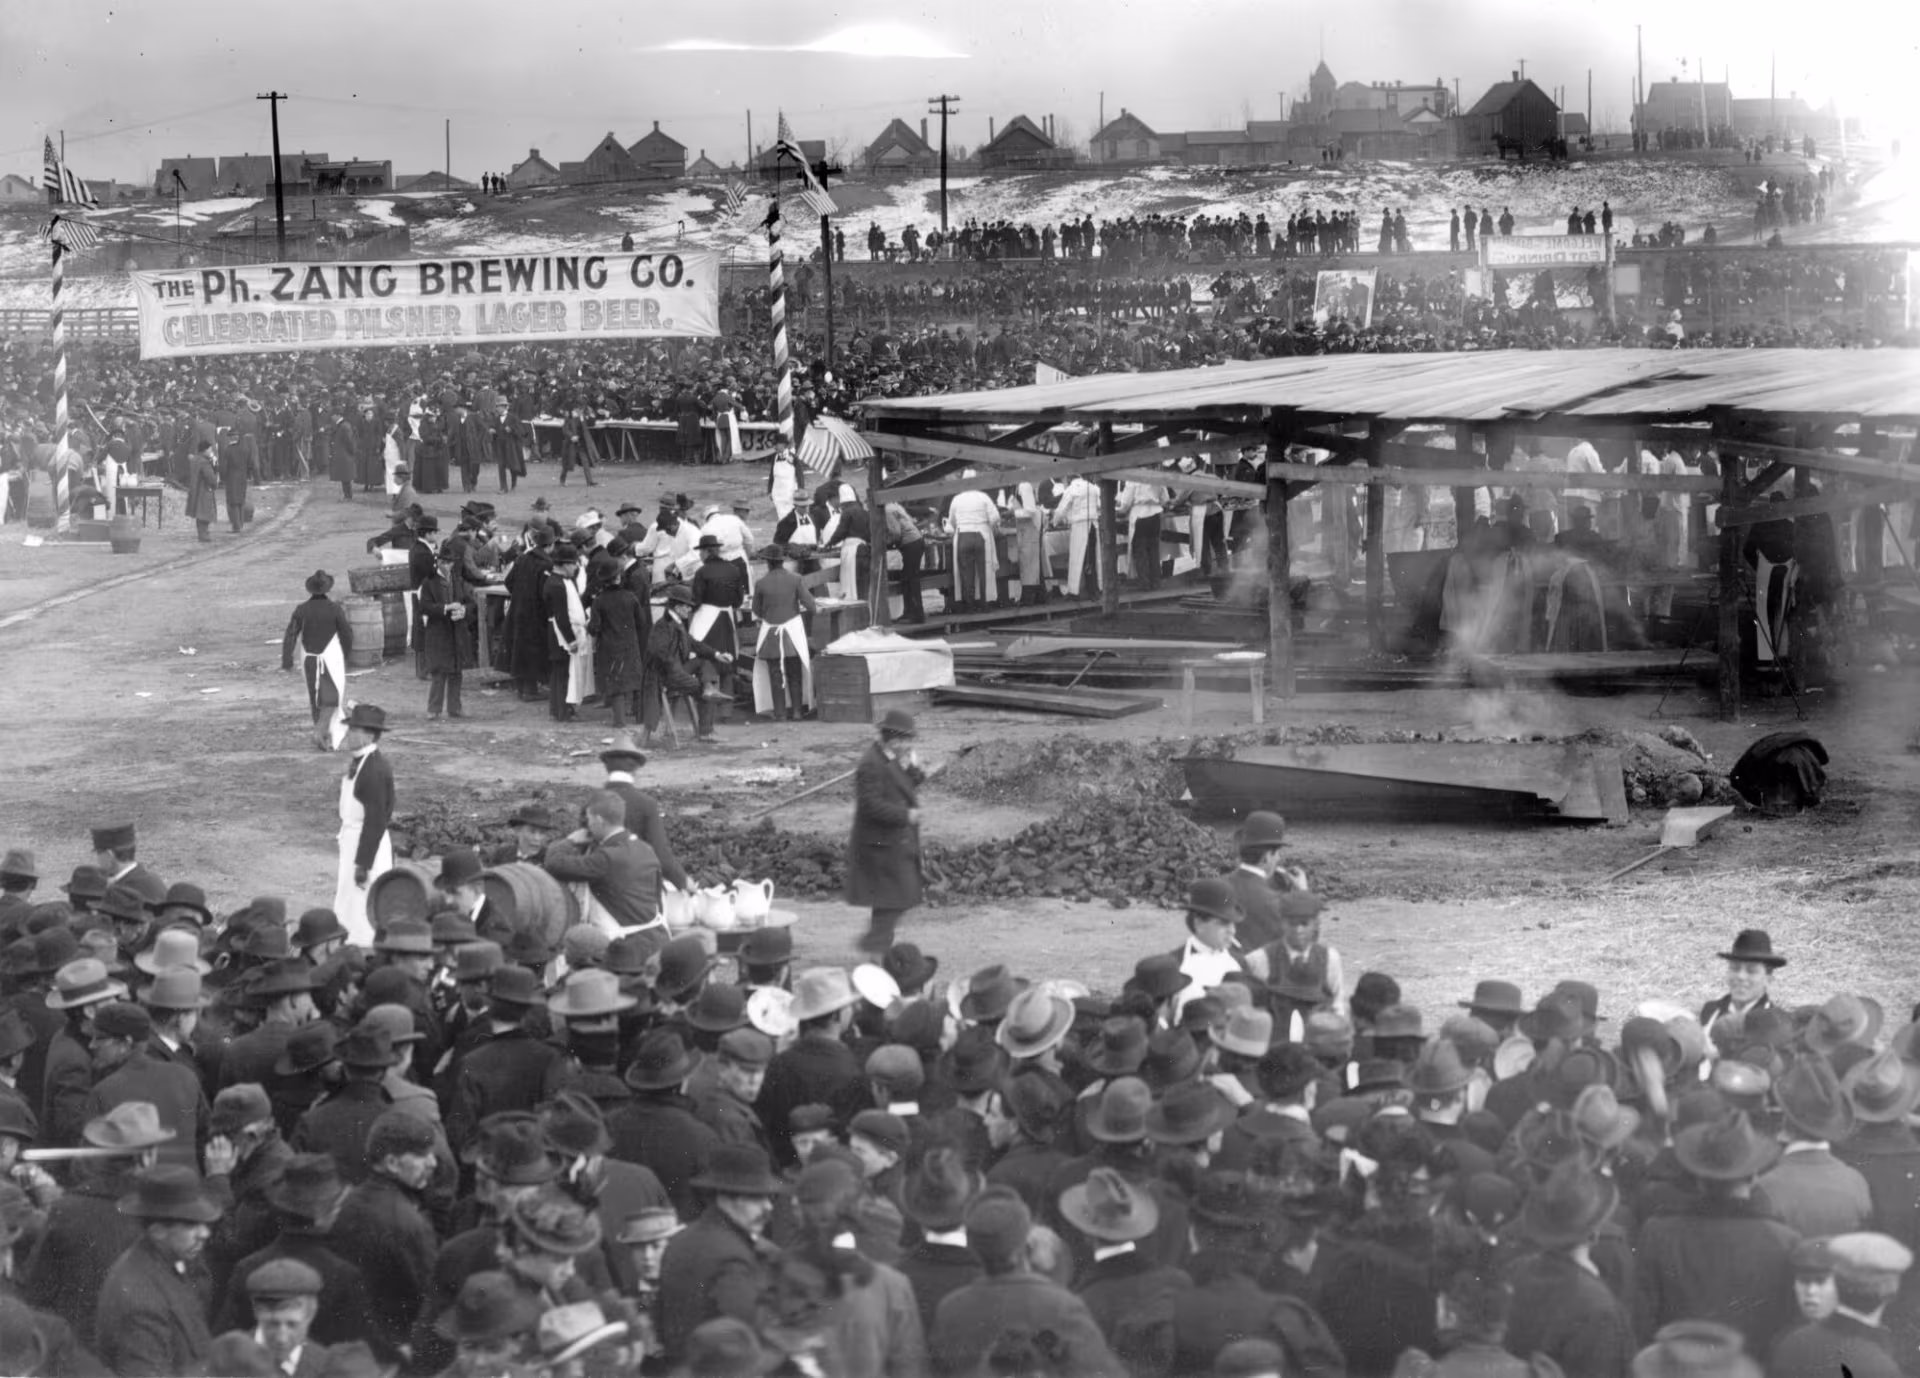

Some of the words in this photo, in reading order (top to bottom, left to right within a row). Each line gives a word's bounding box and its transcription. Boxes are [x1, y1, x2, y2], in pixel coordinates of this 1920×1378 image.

[152, 279, 194, 299] THE
[202, 269, 260, 304] Ph.
[270, 265, 397, 301] ZANG
[419, 256, 608, 295] BREWING
[630, 254, 695, 288] CO.
[163, 309, 337, 347] CELEBRATED
[344, 303, 462, 340] PILSNER
[475, 300, 568, 334] LAGER
[580, 298, 674, 332] BEER.
